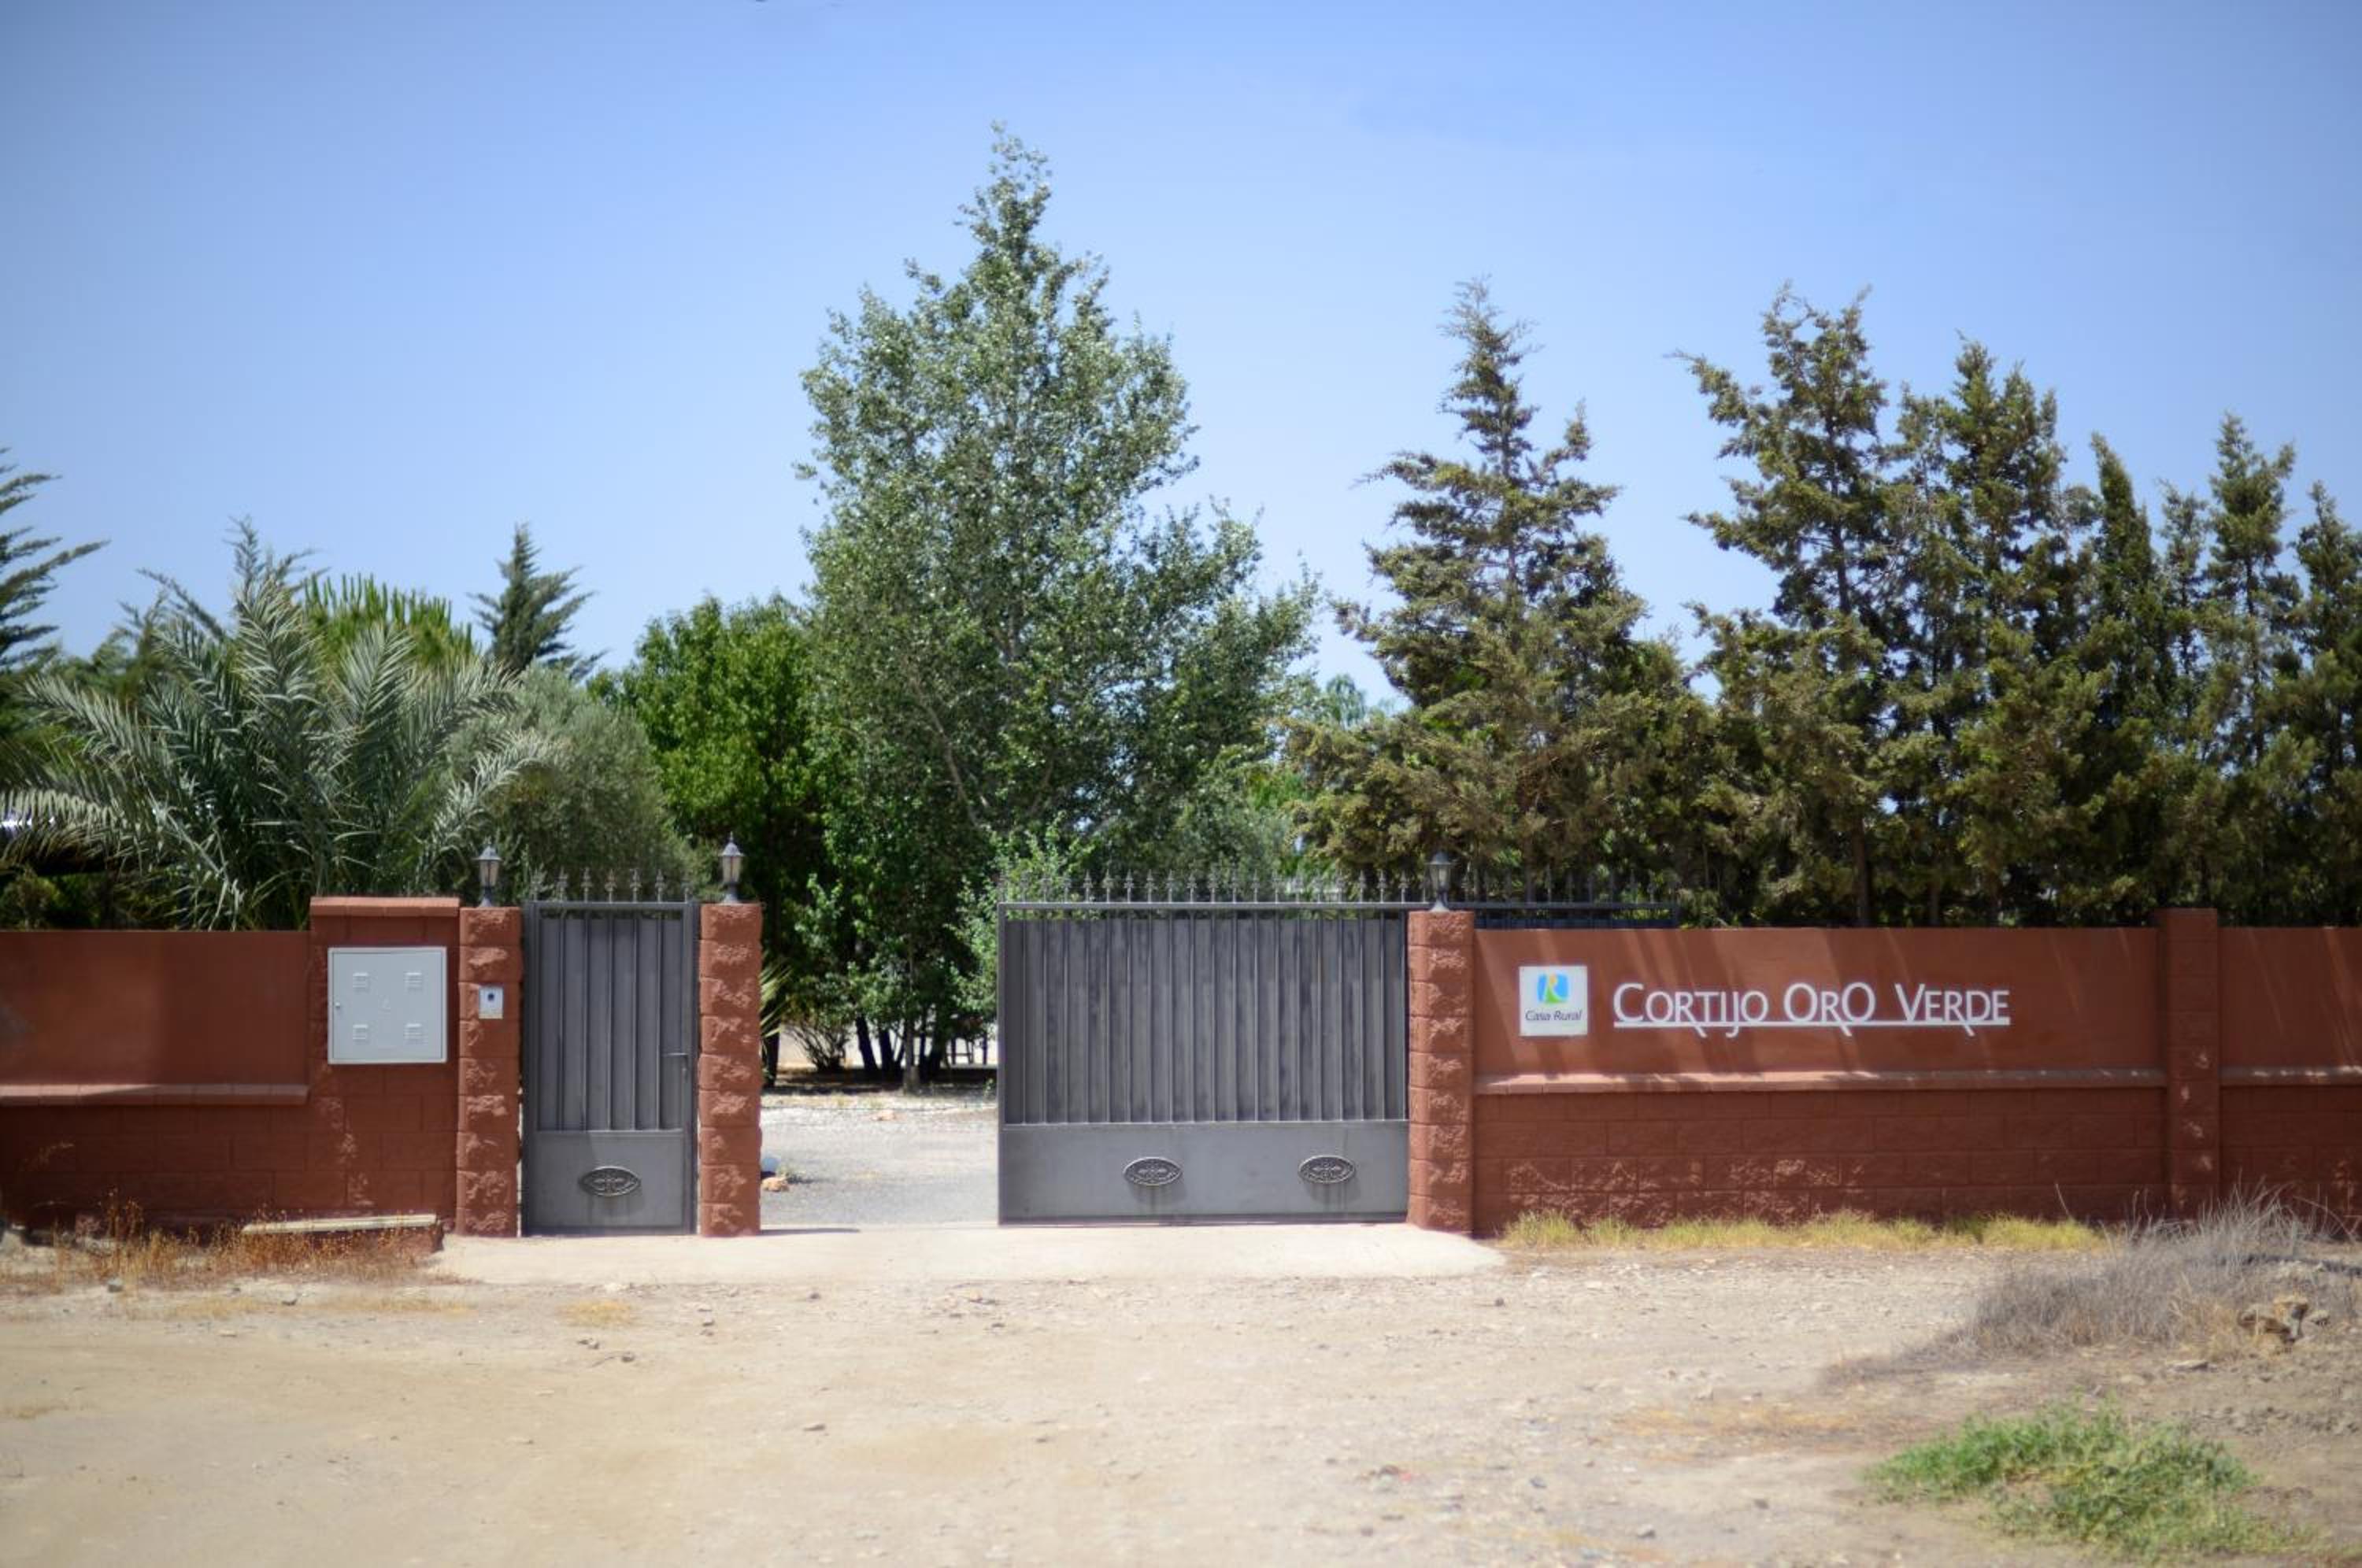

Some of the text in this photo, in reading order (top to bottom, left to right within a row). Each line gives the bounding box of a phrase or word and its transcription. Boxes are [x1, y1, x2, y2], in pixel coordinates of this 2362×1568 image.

[1525, 1009, 1583, 1021] Casa Rural
[1613, 982, 1769, 1037] CORTIJO
[1894, 983, 2010, 1037] VERDE
